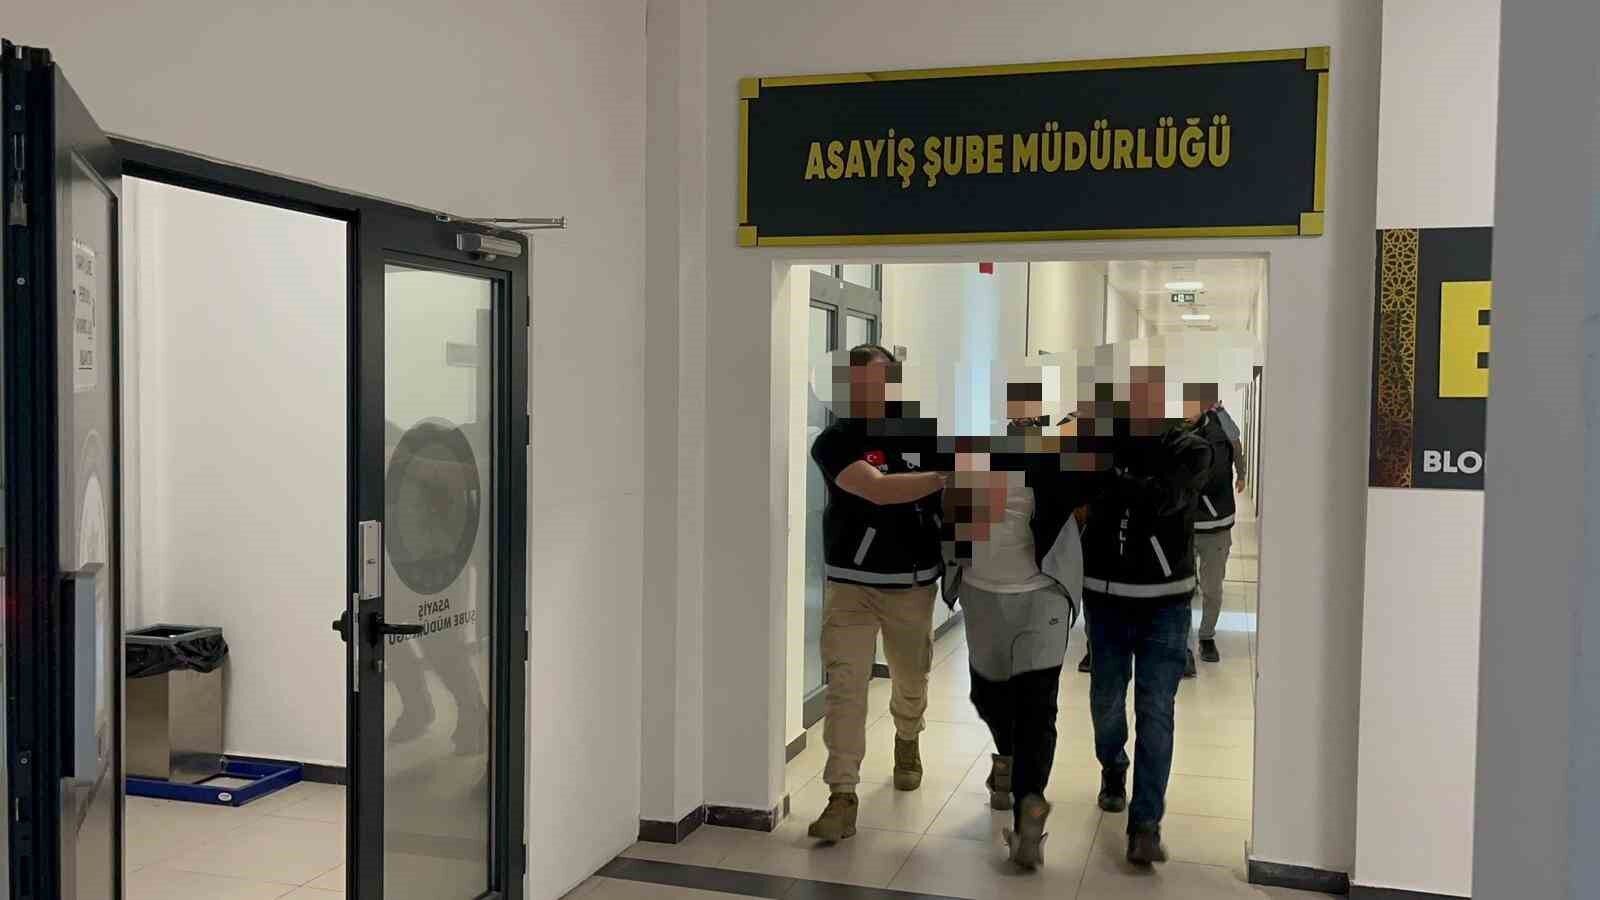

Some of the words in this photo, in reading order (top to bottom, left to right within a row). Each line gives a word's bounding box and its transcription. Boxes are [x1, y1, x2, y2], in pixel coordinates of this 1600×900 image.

[805, 128, 915, 188] ASAYİŞ
[923, 134, 1004, 187] ŞUBE
[1012, 115, 1232, 173] MÜDÜRLÜĞÜ
[1423, 450, 1486, 475] BLO
